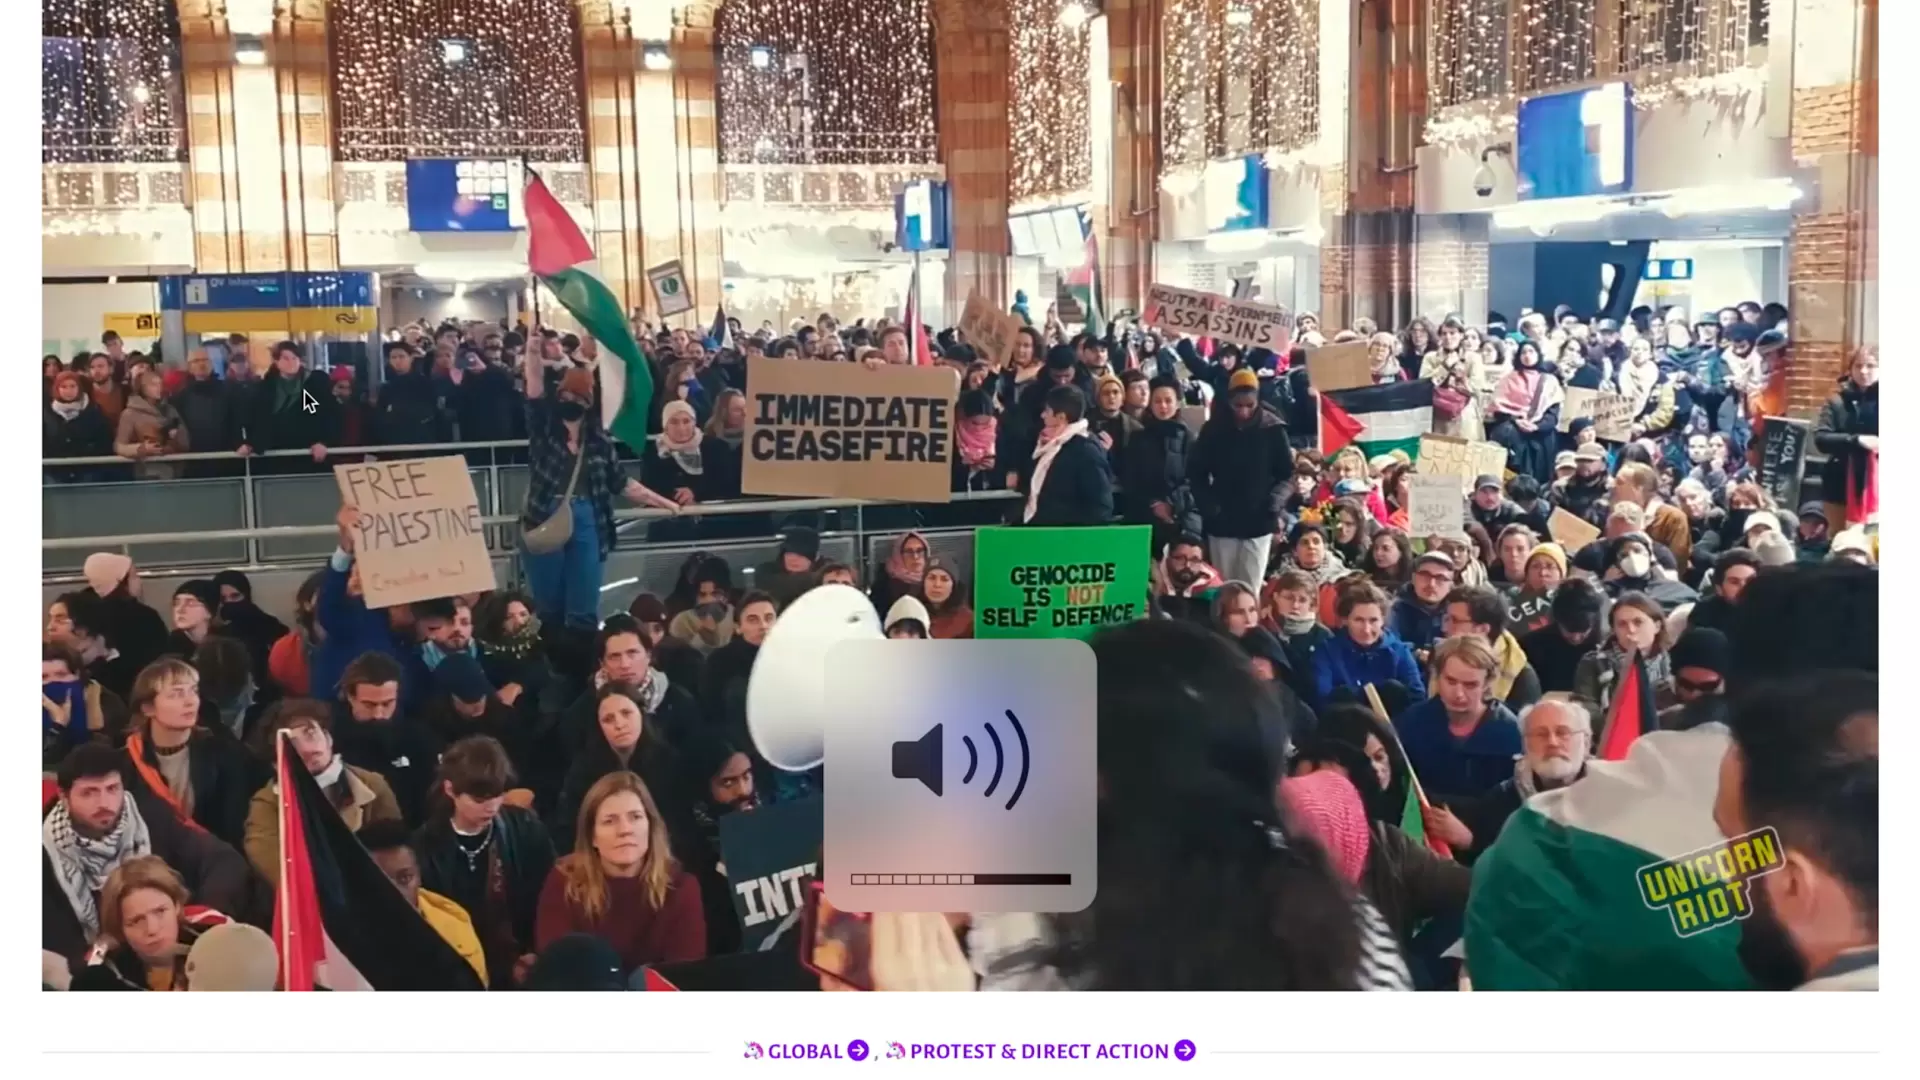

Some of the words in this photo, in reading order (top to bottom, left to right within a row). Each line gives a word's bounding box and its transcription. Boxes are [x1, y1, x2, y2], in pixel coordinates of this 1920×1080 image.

[1151, 288, 1217, 312] NEUTRAL
[1154, 305, 1272, 343] ASSASSINS
[754, 393, 949, 429] IMMEDIATE
[752, 429, 948, 463] CEASEFIRE
[347, 462, 433, 506] FREE
[359, 504, 482, 552] PALESTINE
[1010, 562, 1116, 586] GENOCIDE
[1023, 587, 1051, 607] IS
[1067, 585, 1105, 605] NOT
[982, 607, 1038, 627] SELF
[1052, 603, 1135, 628] DEFENCE
